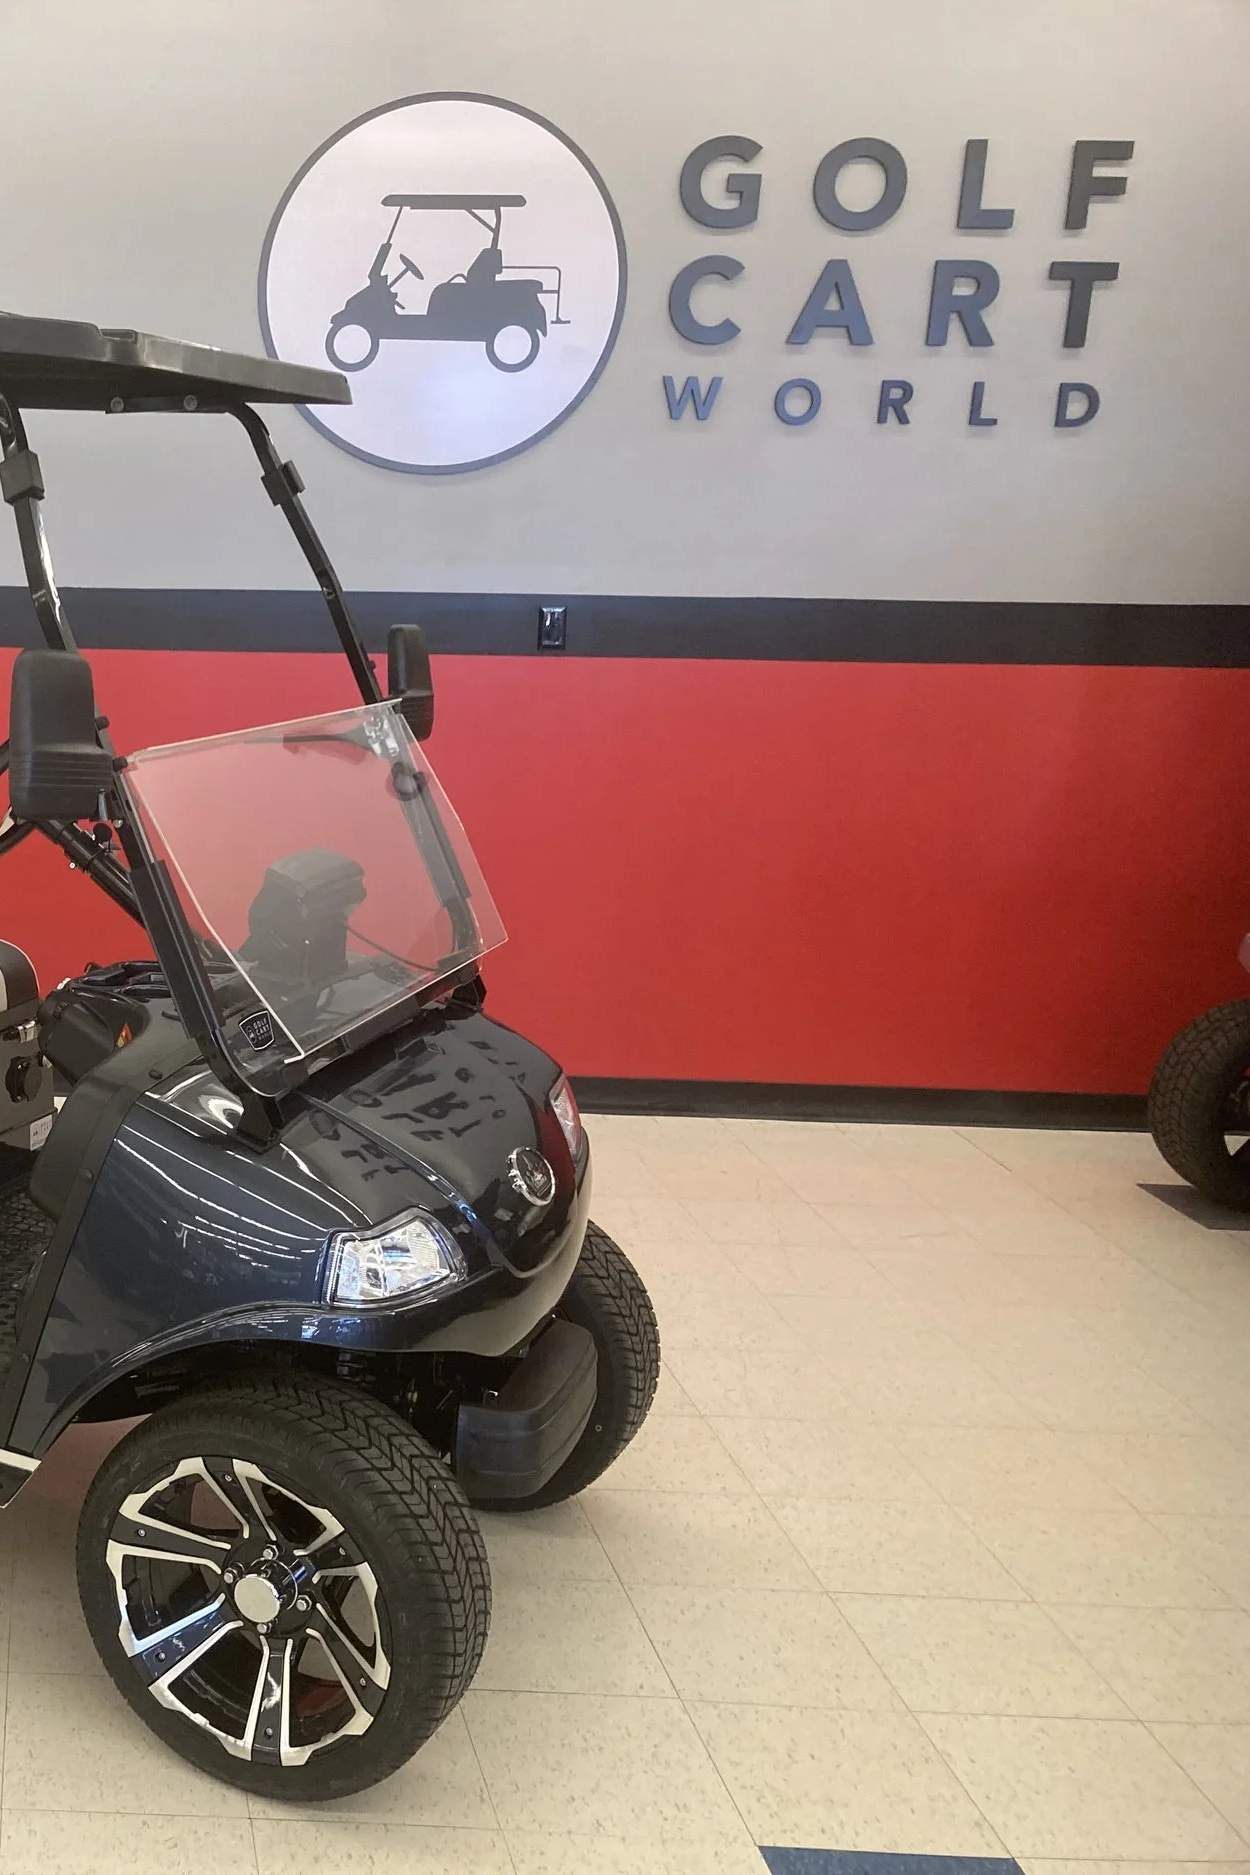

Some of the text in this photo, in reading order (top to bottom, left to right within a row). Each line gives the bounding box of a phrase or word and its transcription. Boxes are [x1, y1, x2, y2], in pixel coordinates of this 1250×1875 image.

[679, 135, 1136, 231] GOLF
[668, 255, 1120, 348] CART
[662, 375, 1101, 428] WORLD
